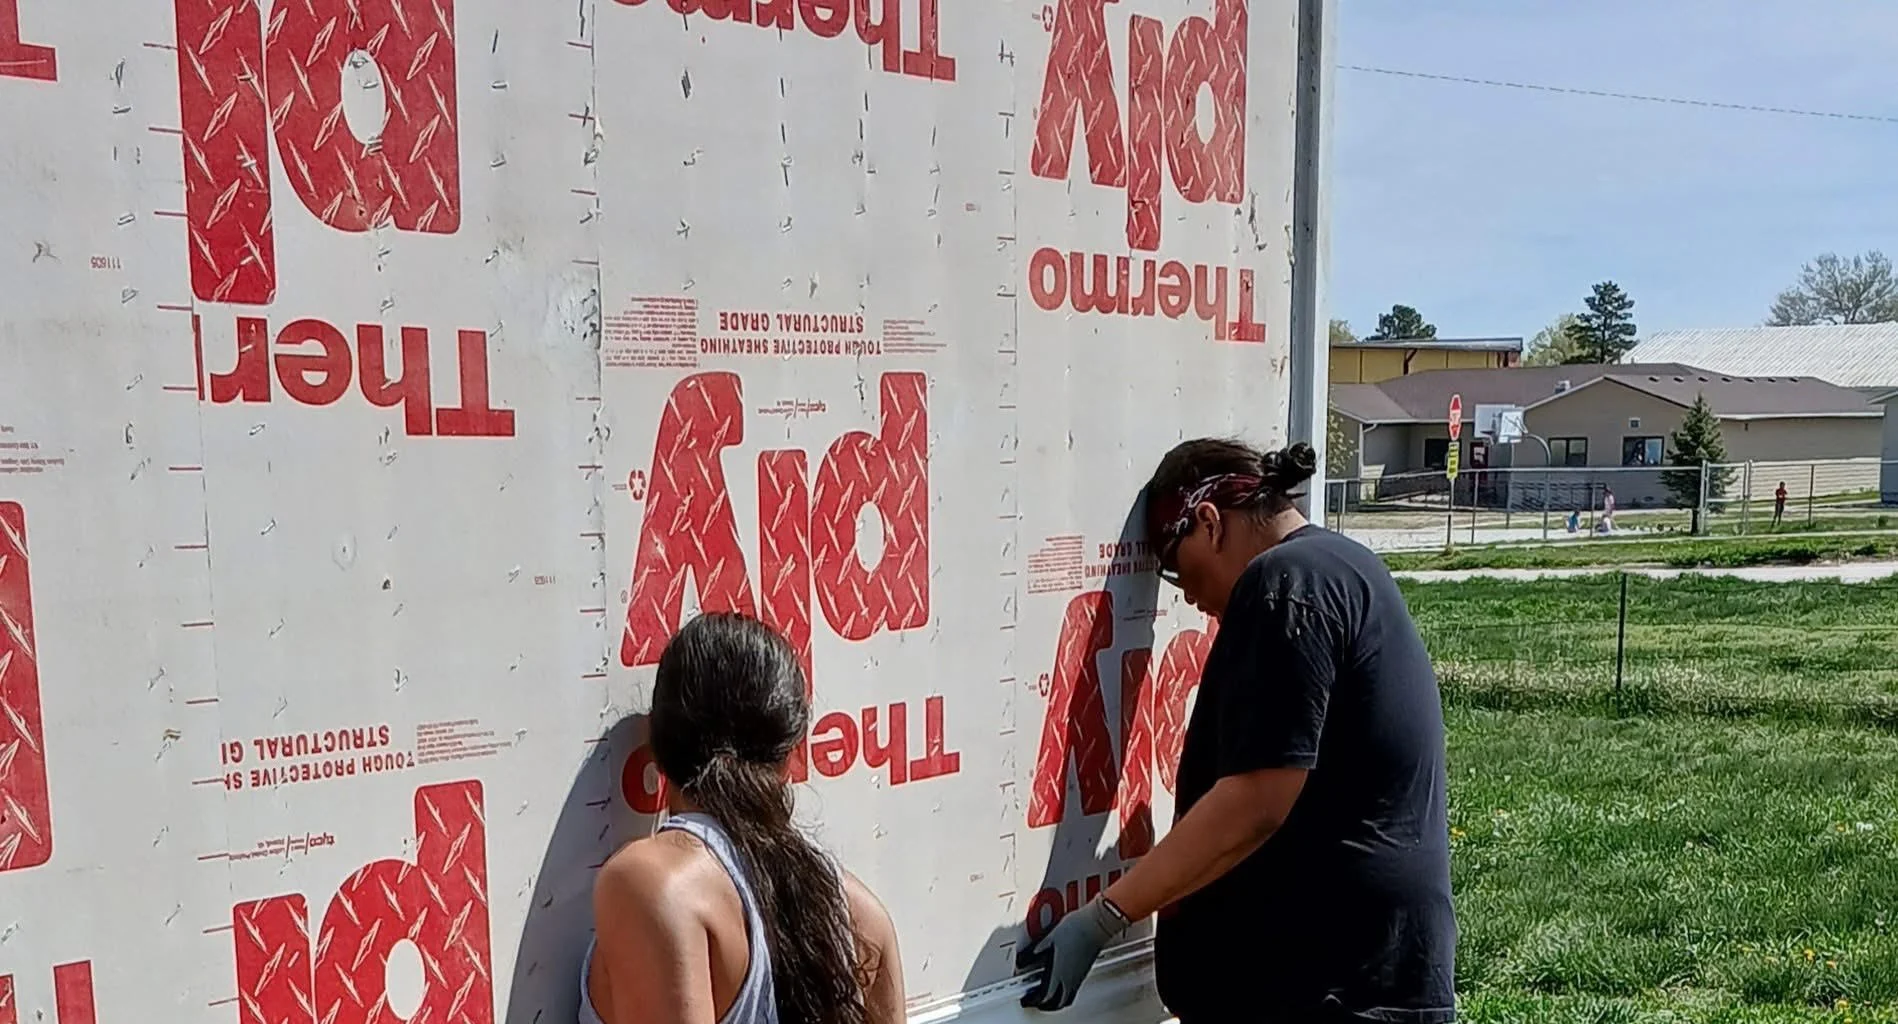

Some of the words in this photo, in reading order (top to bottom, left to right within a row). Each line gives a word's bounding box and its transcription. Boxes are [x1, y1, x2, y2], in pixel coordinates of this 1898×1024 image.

[1028, 247, 1267, 343] Thermo
[719, 311, 769, 332] GRADE
[776, 313, 864, 334] STRUCTURAL
[700, 338, 769, 354] SHEATHING
[773, 338, 841, 355] PROTECTIVE
[193, 313, 516, 437] Ther
[253, 724, 390, 761] STRUCTURAL
[250, 757, 356, 788] PROTECTIVE
[361, 750, 416, 774] TOUGH
